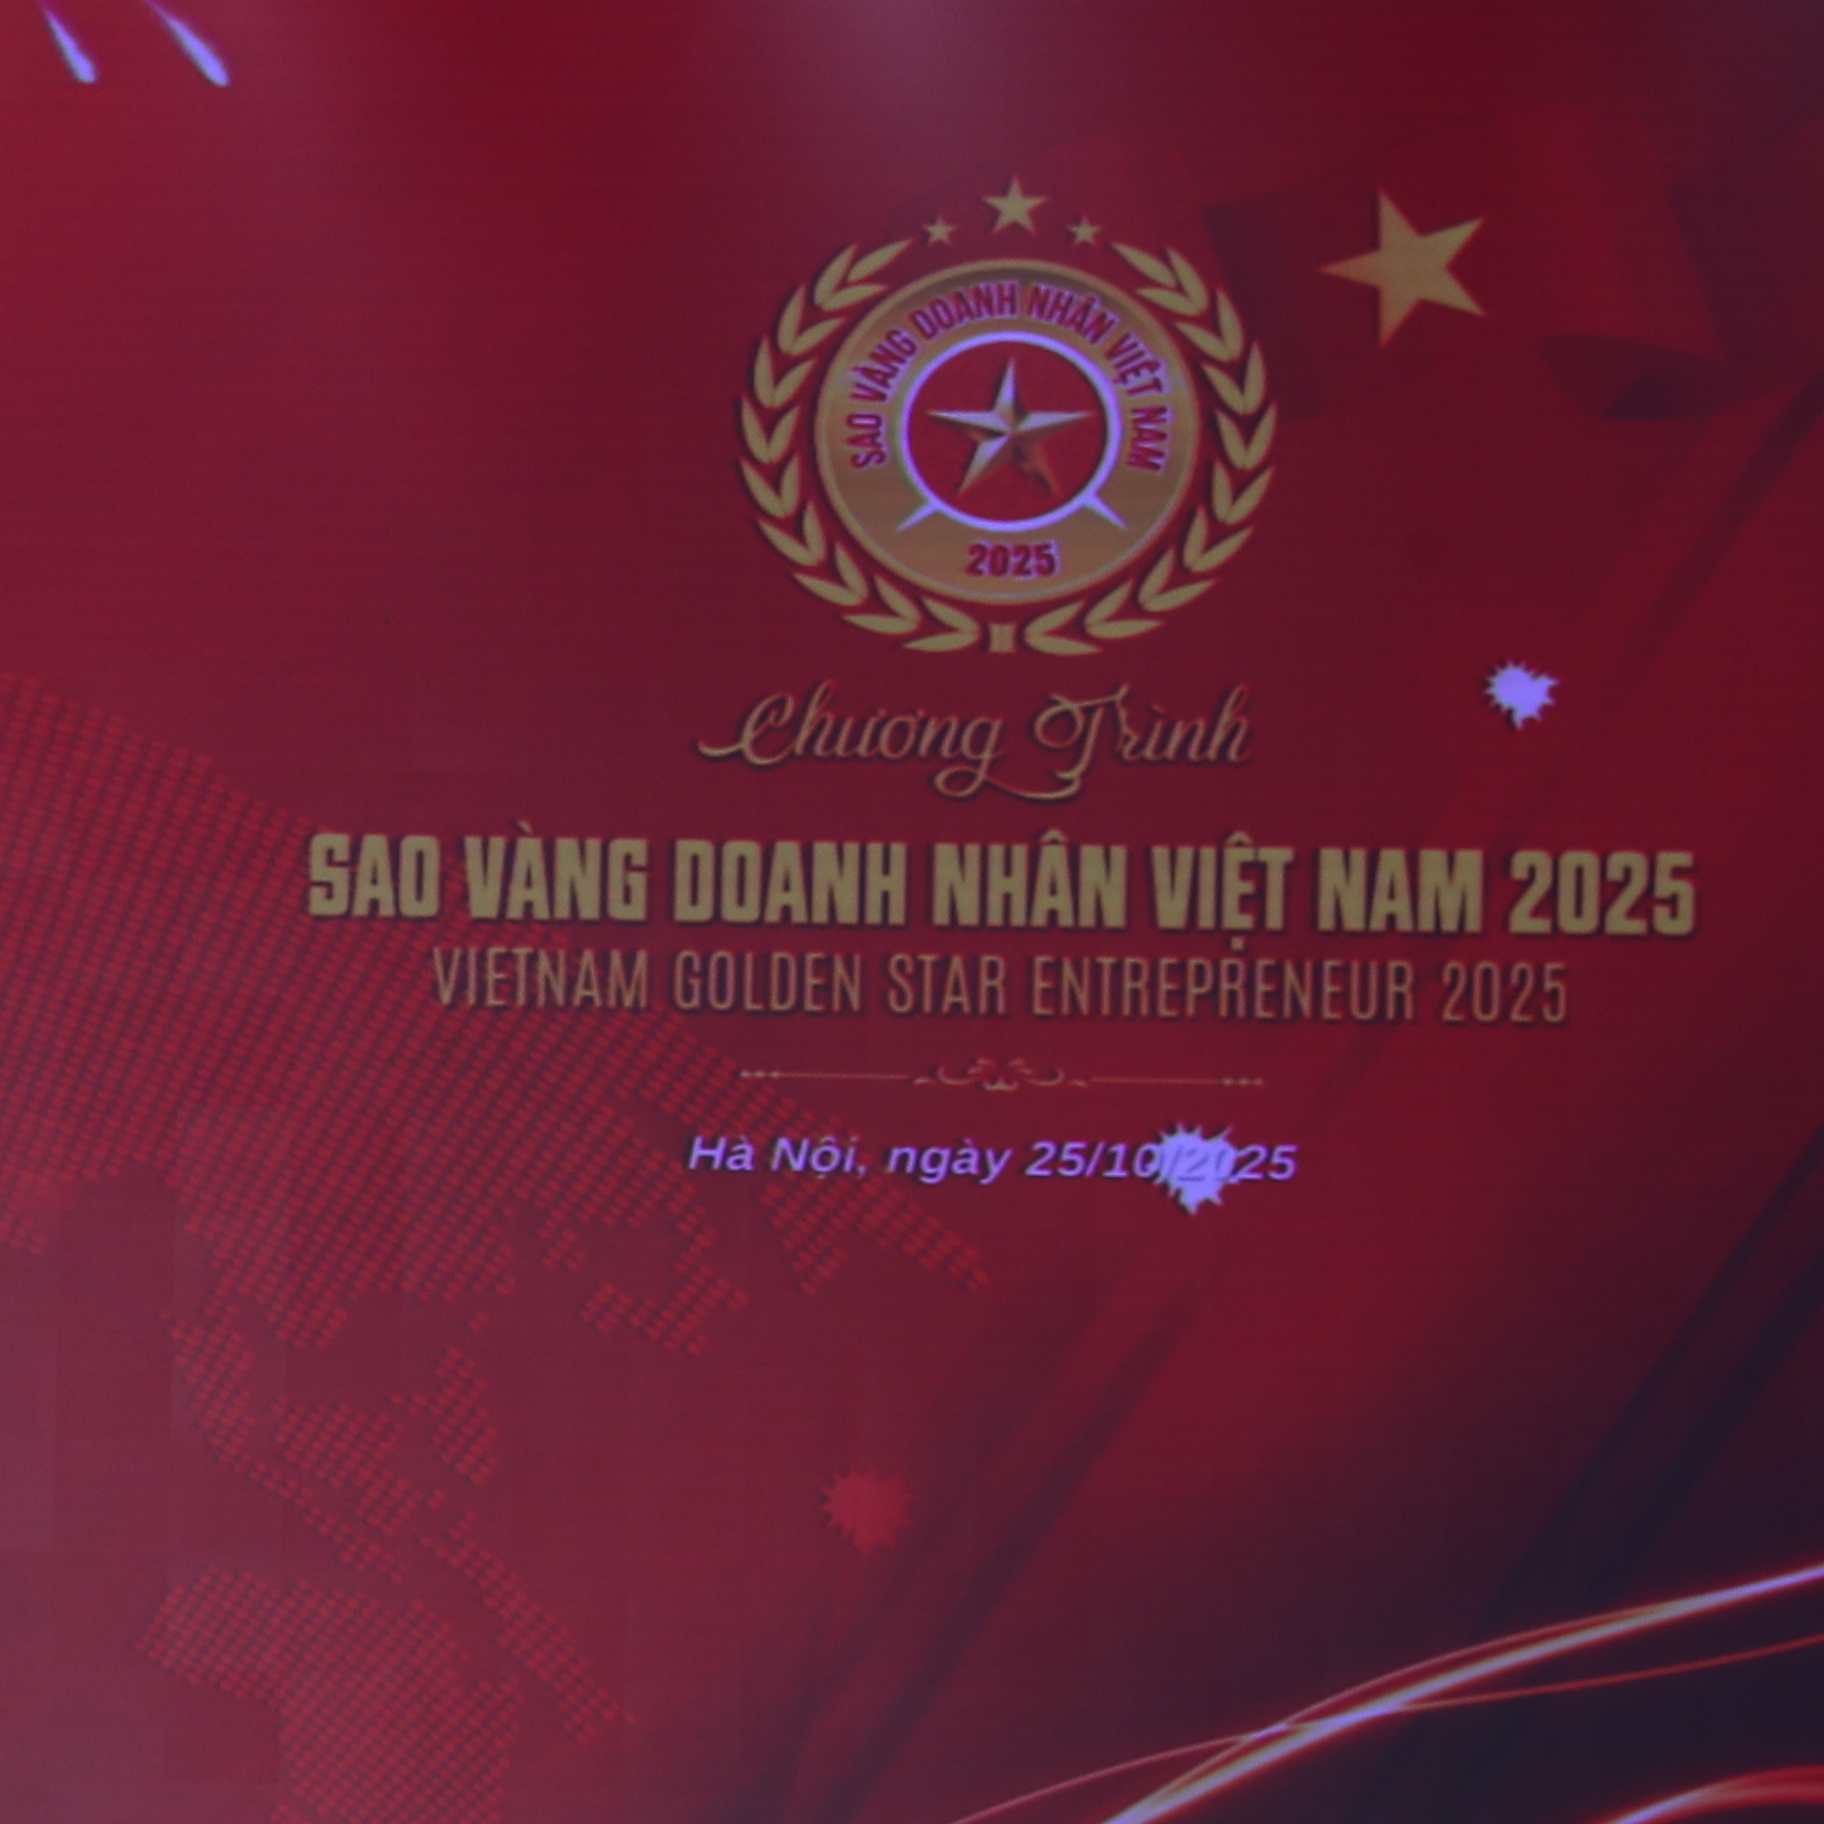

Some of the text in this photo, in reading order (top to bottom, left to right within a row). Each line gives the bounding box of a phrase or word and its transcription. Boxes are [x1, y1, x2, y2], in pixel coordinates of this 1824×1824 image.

[846, 282, 1172, 472] SAO VÀNG DOANH NHÂN VIỆT NAM
[965, 543, 1056, 577] 2025
[697, 680, 1254, 798] Chương Trình
[308, 821, 1694, 951] SAO VÀNG DOANH NHÂN VIỆT NAM 2025
[432, 946, 1568, 1023] VIETNAM GOLDEN STAR ENTREPRENEUR 2025
[688, 1135, 756, 1171] Hà
[771, 1135, 868, 1179] Nội,
[888, 1141, 1012, 1183] ngày
